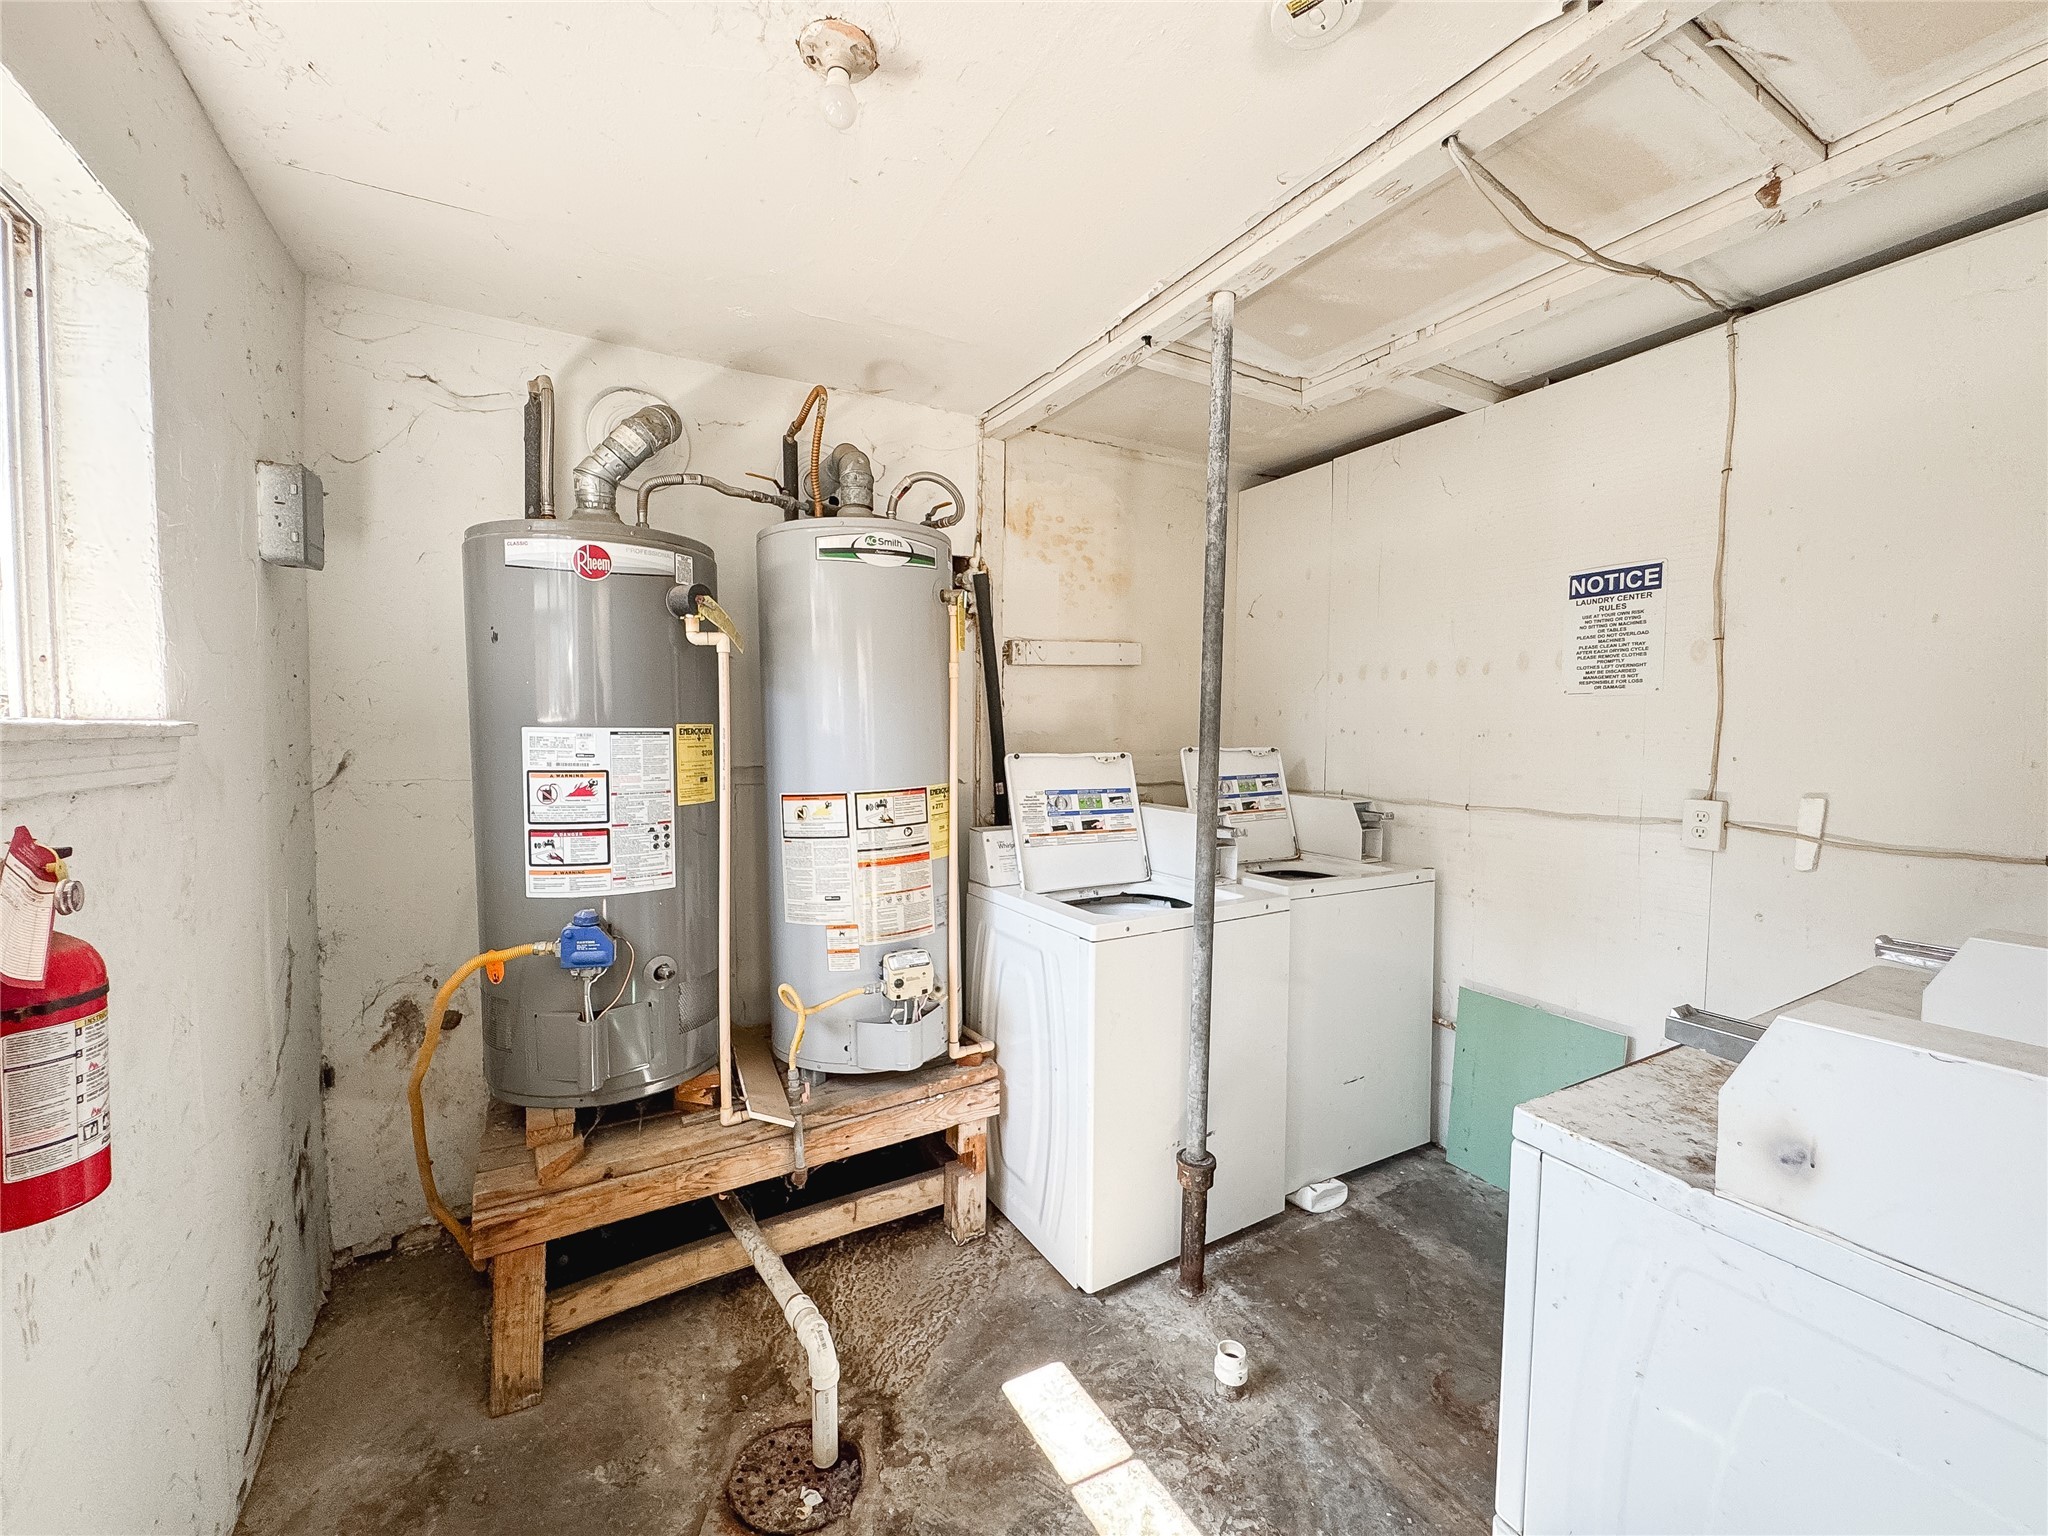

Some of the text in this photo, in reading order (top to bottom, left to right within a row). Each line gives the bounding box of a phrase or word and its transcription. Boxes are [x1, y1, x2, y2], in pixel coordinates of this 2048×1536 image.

[878, 537, 902, 547] Smith
[577, 544, 610, 575] Rheem
[1571, 567, 1660, 596] NOTICE
[1576, 592, 1653, 606] LAUNDRY CENTER
[1599, 603, 1627, 612] RULES
